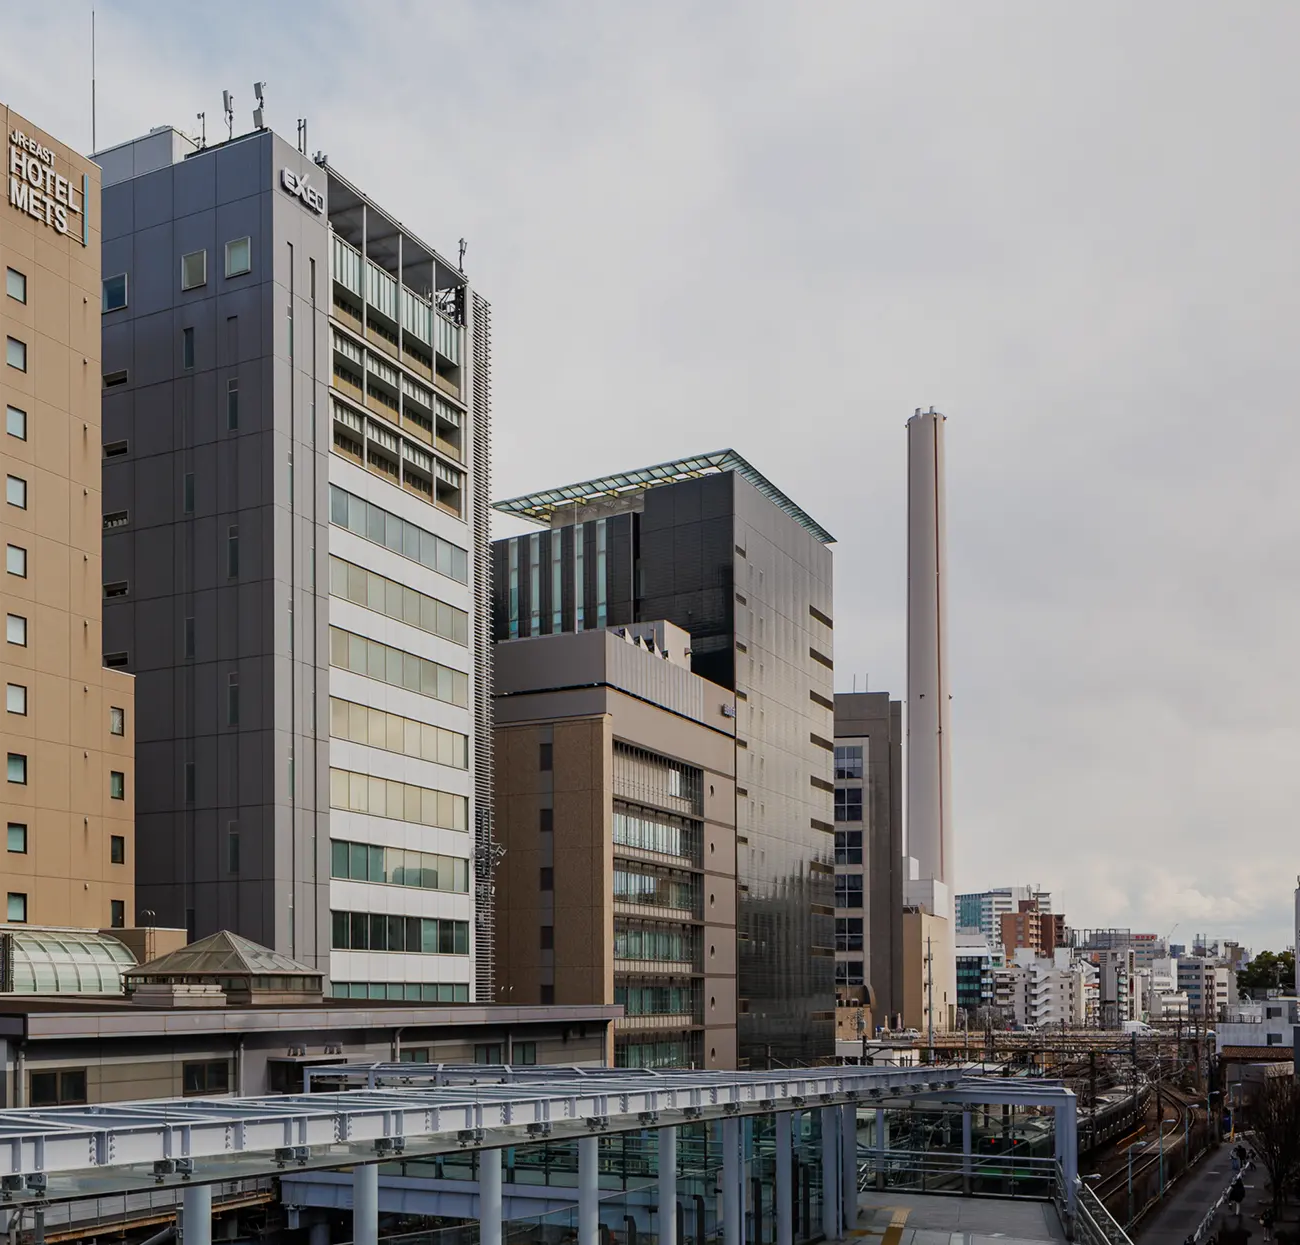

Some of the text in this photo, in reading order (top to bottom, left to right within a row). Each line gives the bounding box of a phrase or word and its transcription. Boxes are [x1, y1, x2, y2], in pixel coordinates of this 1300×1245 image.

[10, 145, 80, 212] HOTEL
[10, 176, 68, 233] METS
[282, 166, 325, 214] EXEO
